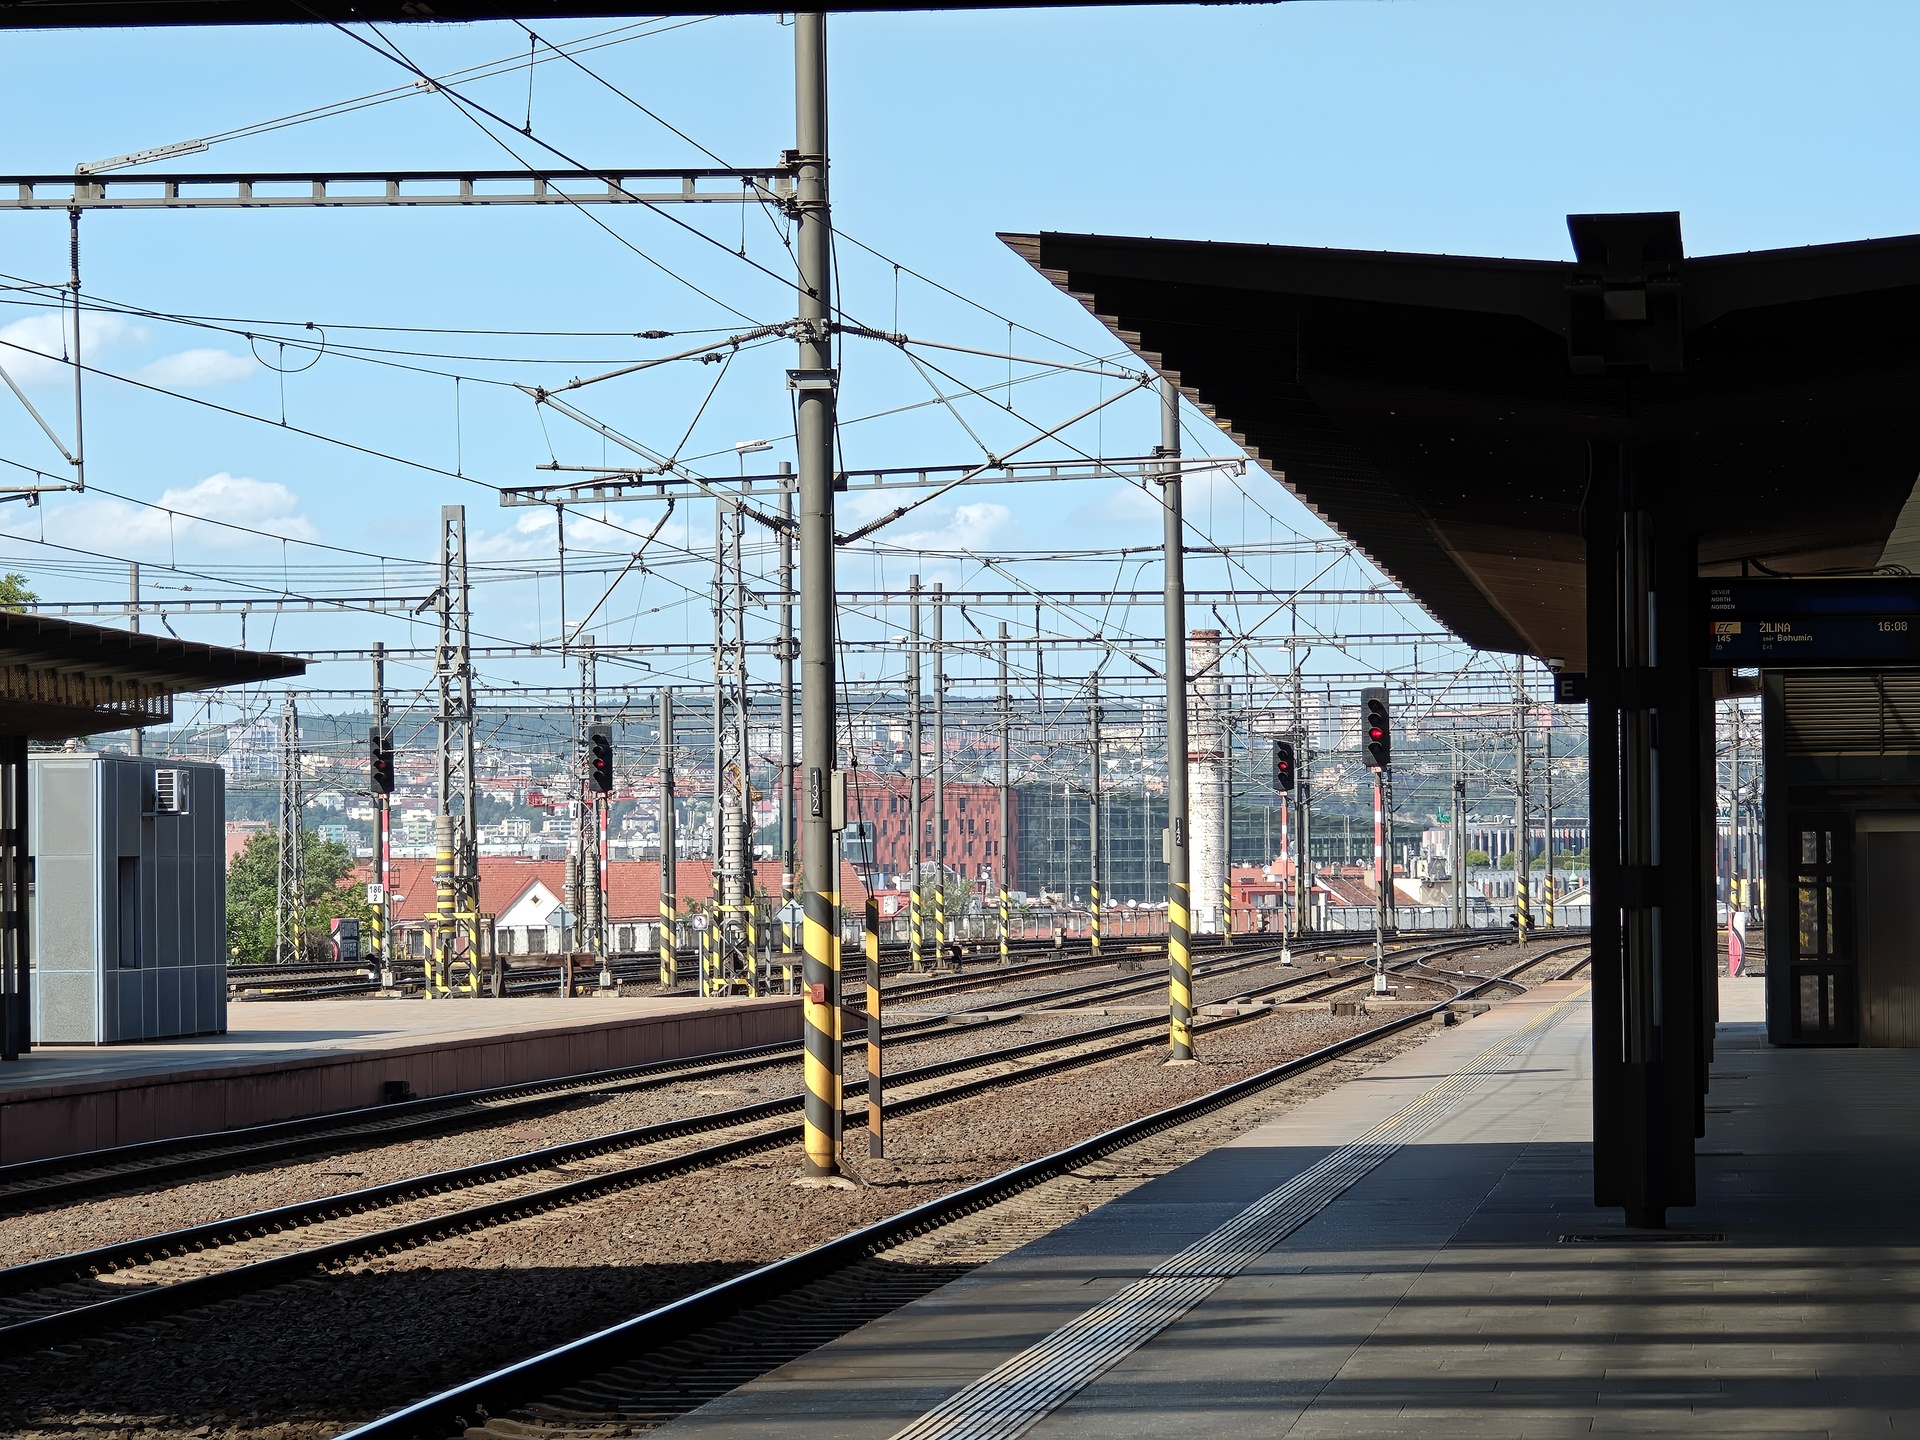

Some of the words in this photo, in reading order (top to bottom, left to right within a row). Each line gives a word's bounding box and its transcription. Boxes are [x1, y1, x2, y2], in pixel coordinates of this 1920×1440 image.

[1716, 623, 1733, 633] EC
[1759, 621, 1791, 633] ŽILINA
[1877, 621, 1908, 632] 16:08
[1777, 634, 1813, 642] Bohumín
[1561, 680, 1574, 697] E
[811, 770, 819, 812] 132
[369, 886, 382, 894] 186
[373, 894, 378, 902] 2
